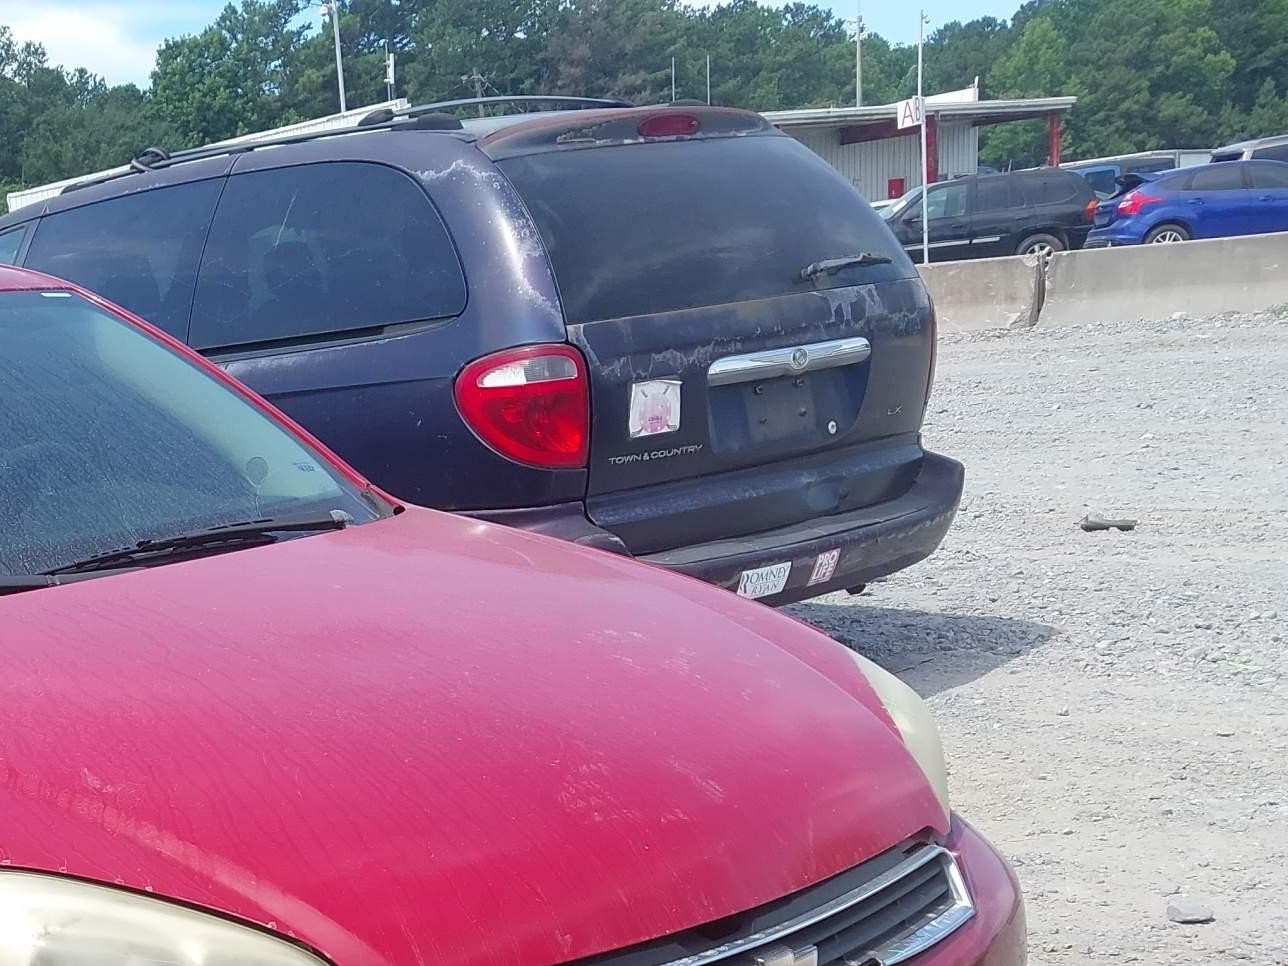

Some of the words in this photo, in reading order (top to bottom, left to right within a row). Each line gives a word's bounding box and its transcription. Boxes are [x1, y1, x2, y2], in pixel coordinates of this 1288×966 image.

[651, 444, 704, 459] COUNTRY
[817, 551, 838, 567] PRO
[813, 563, 834, 579] LIFE
[740, 566, 788, 594] ROMNEY
[752, 582, 779, 594] RYAN
